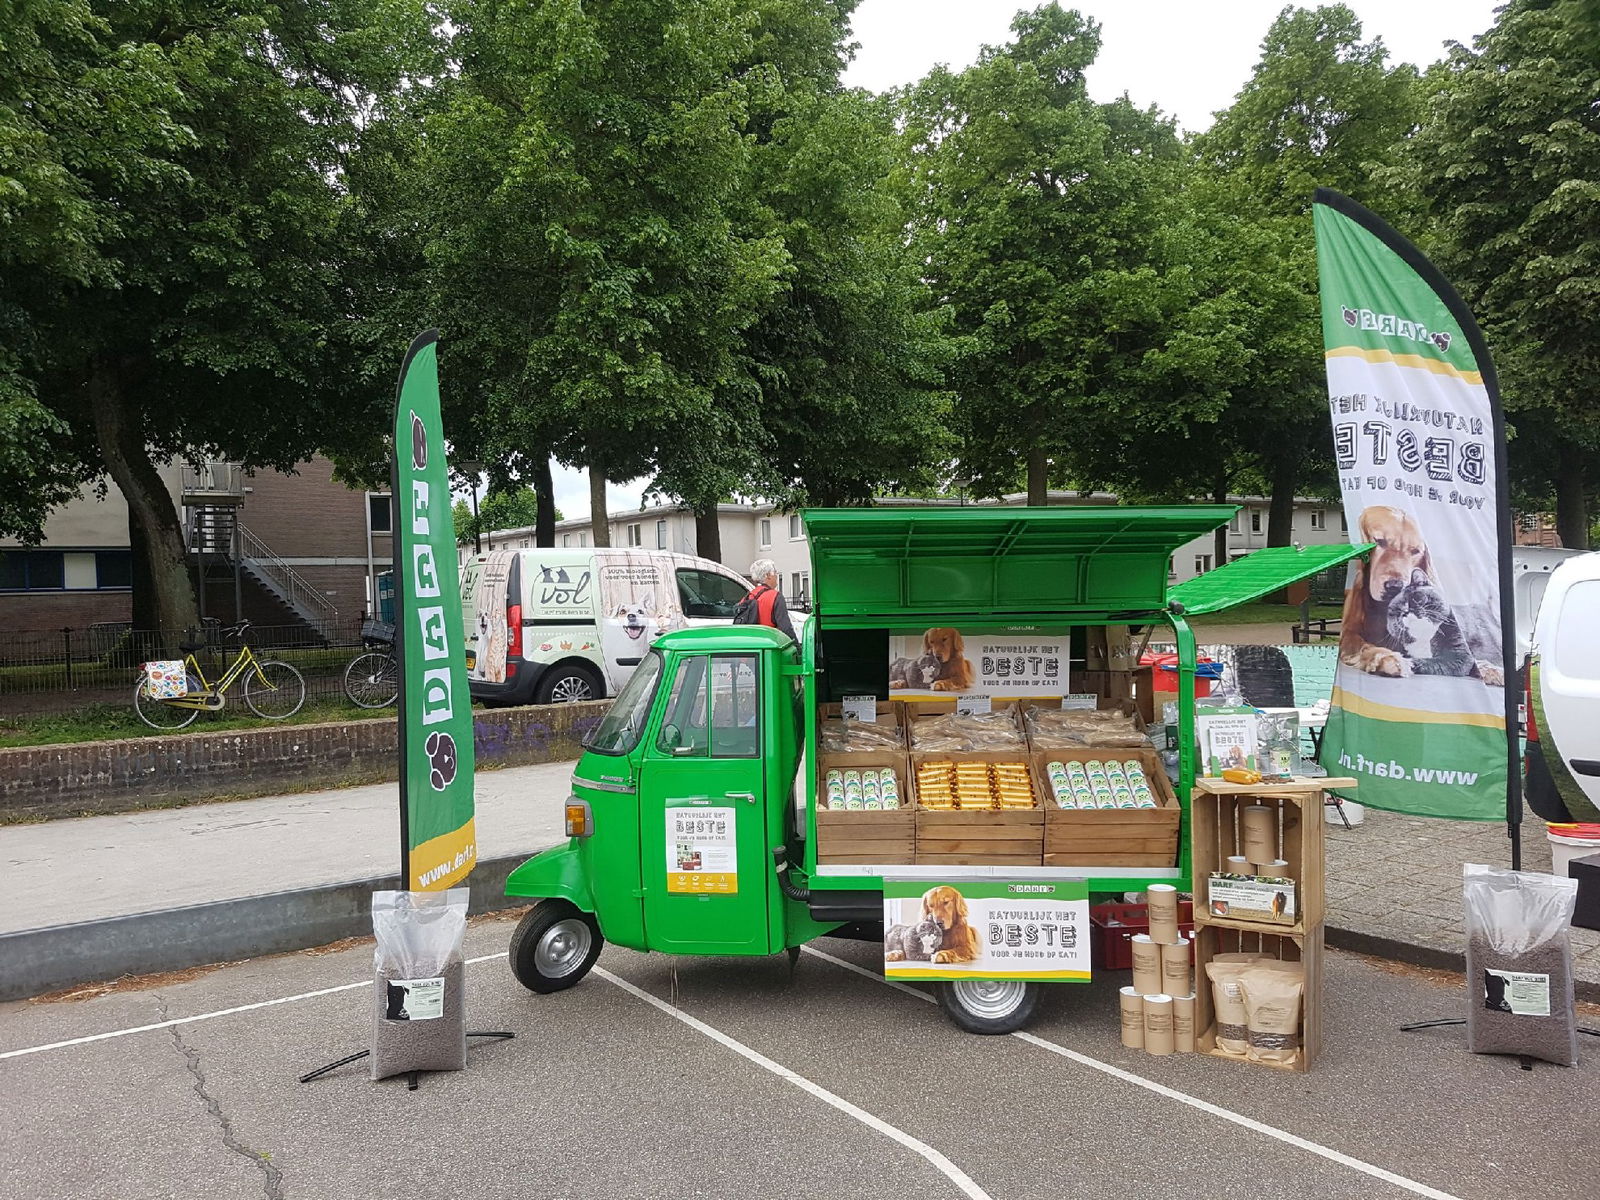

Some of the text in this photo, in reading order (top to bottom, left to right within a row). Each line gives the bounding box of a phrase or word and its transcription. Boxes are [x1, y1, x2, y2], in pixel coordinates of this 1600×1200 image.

[541, 571, 591, 604] vol
[981, 656, 1059, 677] BESTE
[676, 820, 726, 834] BESTE
[1016, 884, 1048, 893] DARF
[988, 911, 1077, 921] NATUURLIJK HET
[988, 922, 1077, 948] BESTE
[991, 950, 1010, 958] VOOR
[1013, 950, 1022, 958] JE
